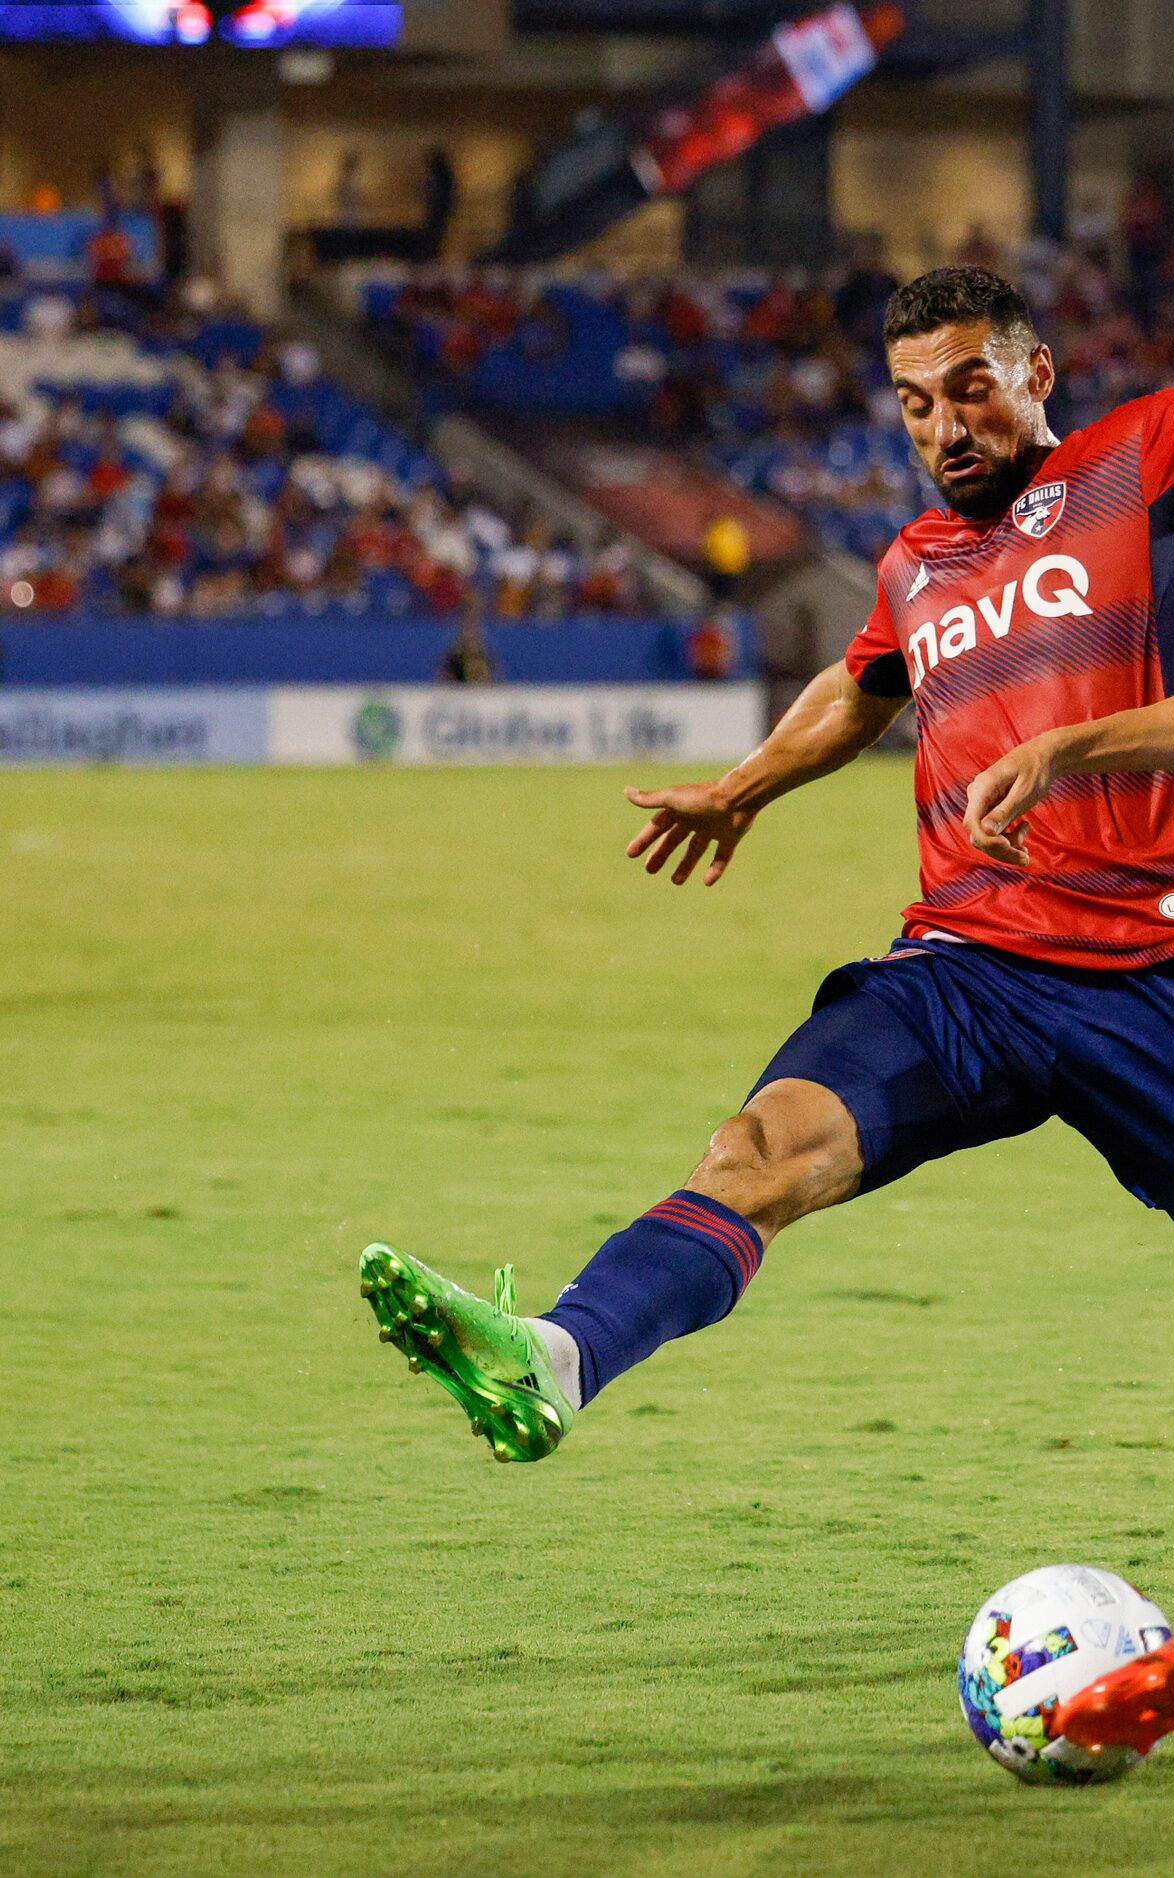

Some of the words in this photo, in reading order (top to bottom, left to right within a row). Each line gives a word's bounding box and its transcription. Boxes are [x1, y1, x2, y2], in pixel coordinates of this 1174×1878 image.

[1016, 498, 1026, 513] FC
[1028, 485, 1061, 505] DALLAS
[908, 554, 1094, 690] navQ
